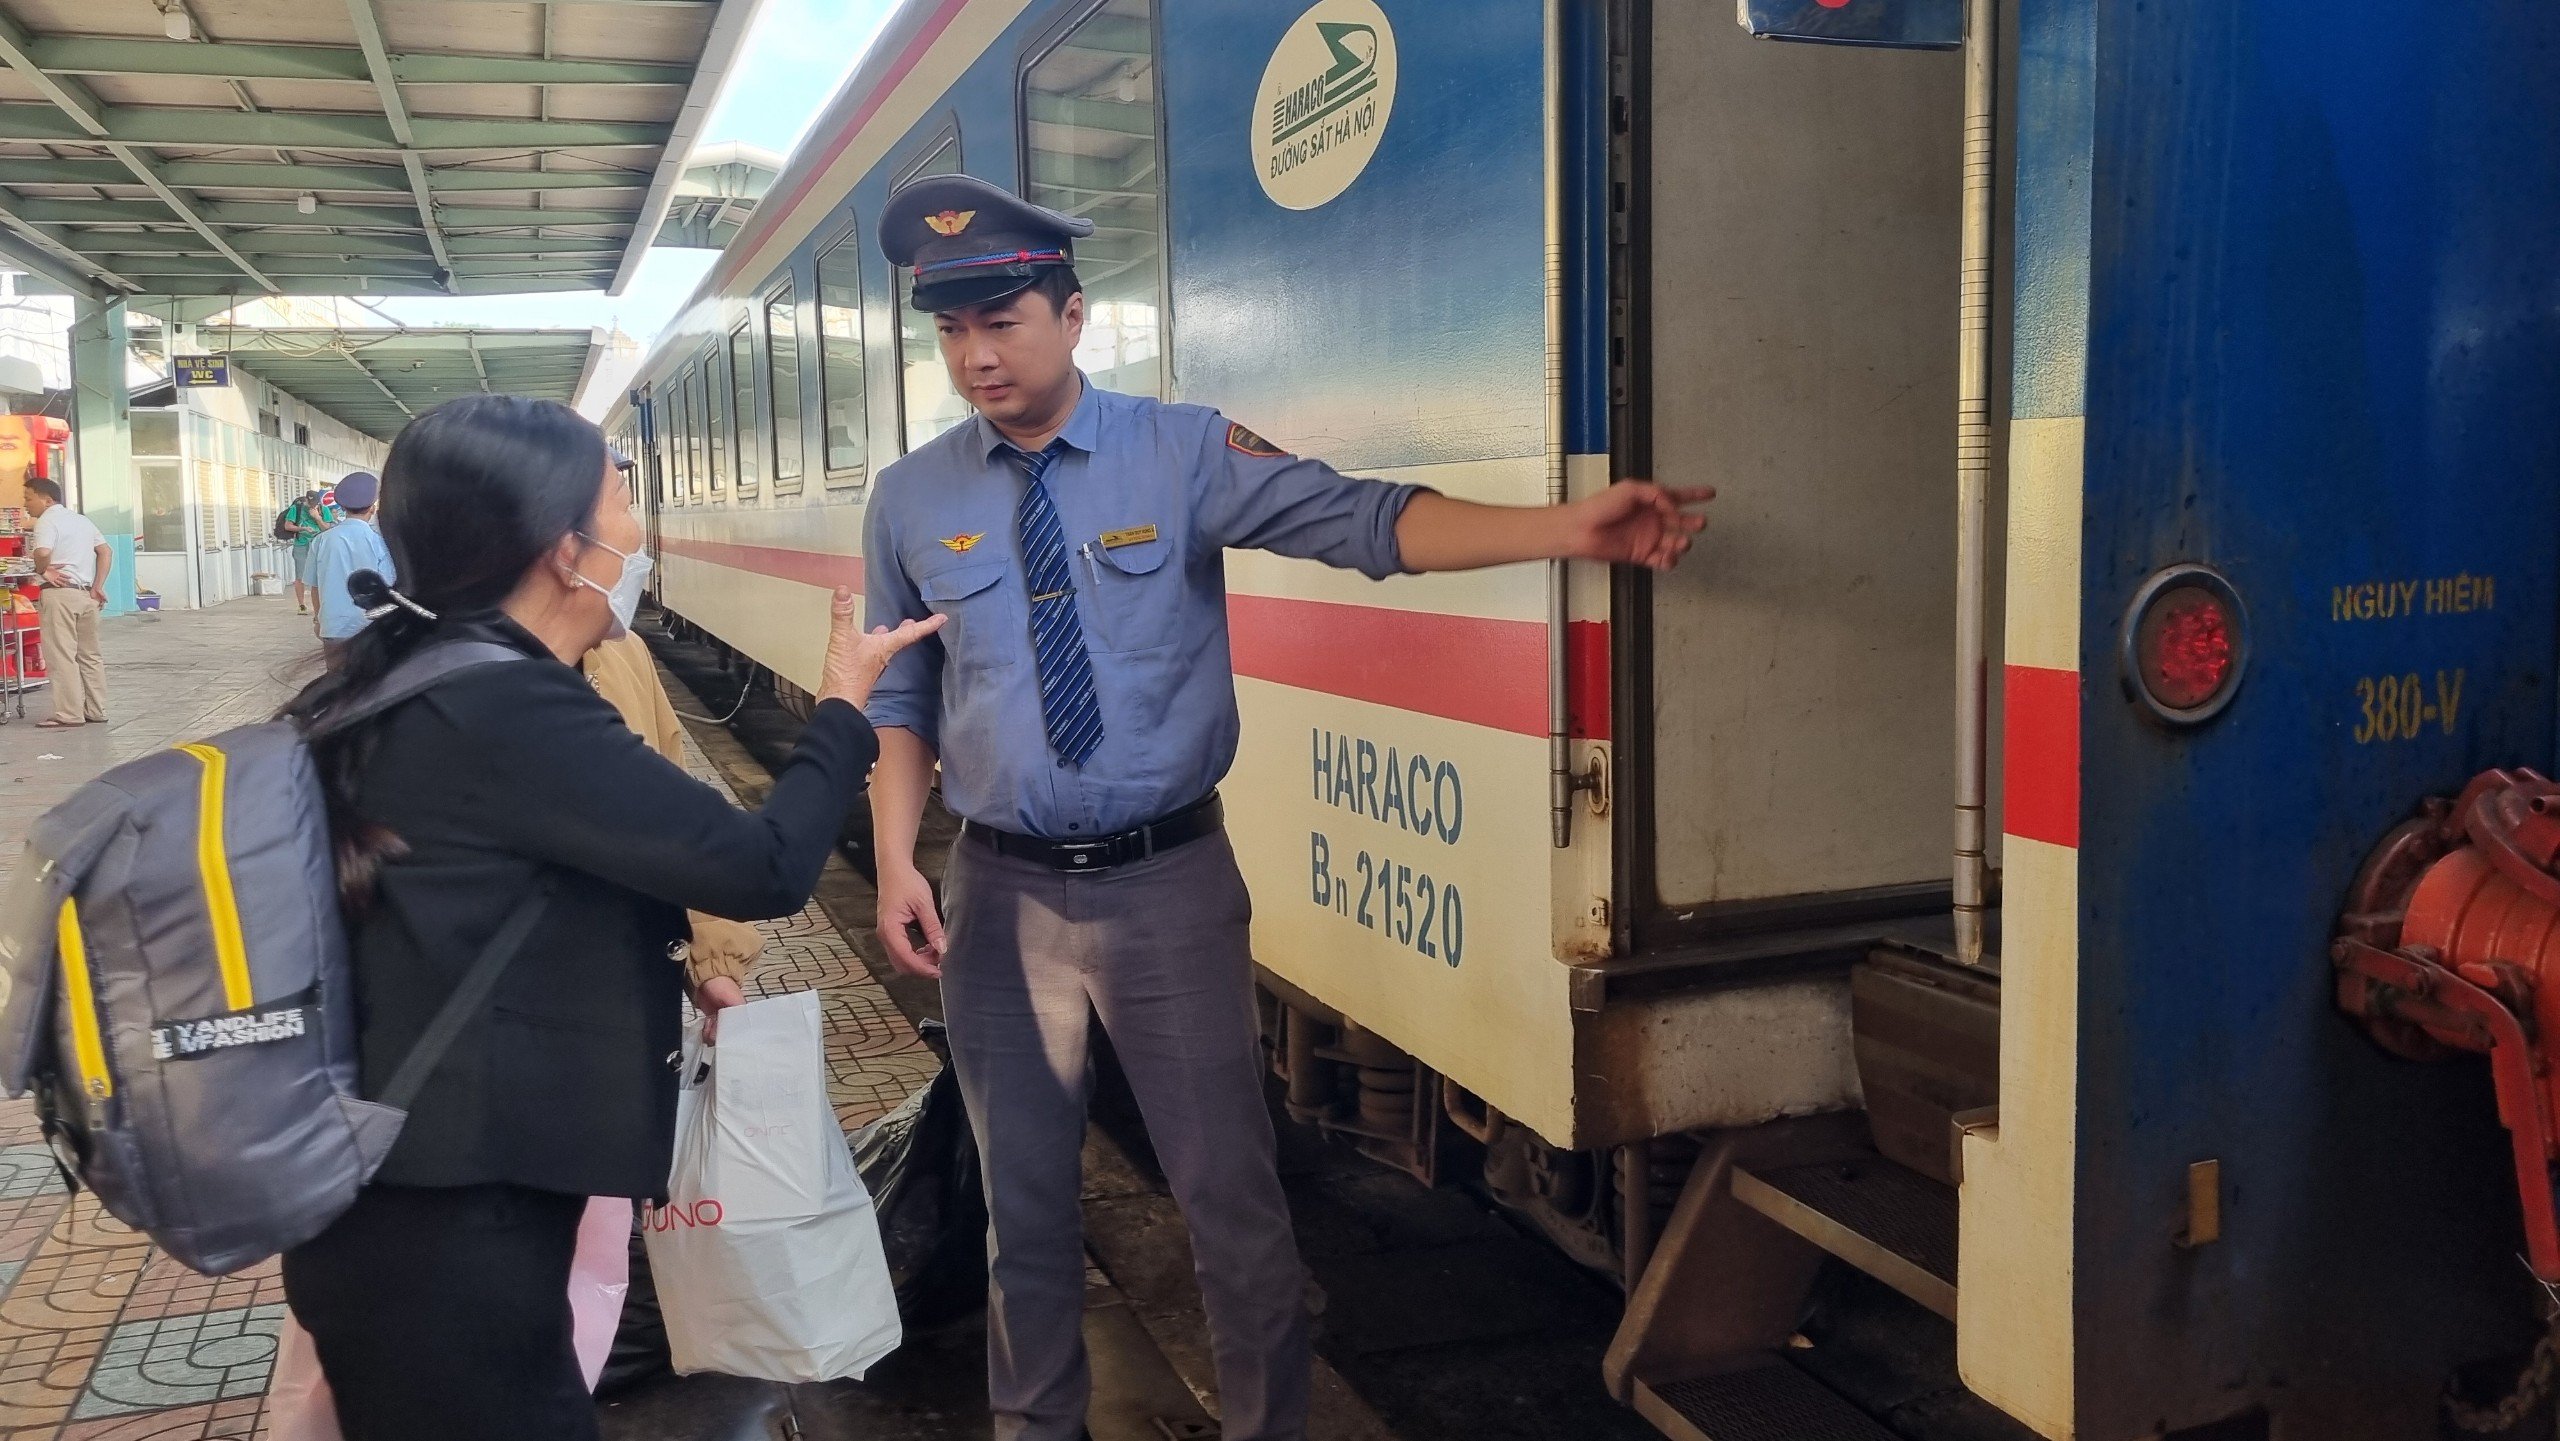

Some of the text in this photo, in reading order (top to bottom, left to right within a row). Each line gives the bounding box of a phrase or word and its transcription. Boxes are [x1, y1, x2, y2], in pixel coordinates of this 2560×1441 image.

[1284, 74, 1325, 127] HARACO
[1271, 97, 1376, 179] ĐƯỜNG SẮT HÀ NỘI
[191, 370, 214, 378] WC
[2332, 580, 2419, 621] NGUY
[2353, 668, 2466, 744] 380-V
[1312, 727, 1463, 845] HARACO
[1356, 850, 1463, 968] 21520
[642, 1199, 723, 1233] JUNO
